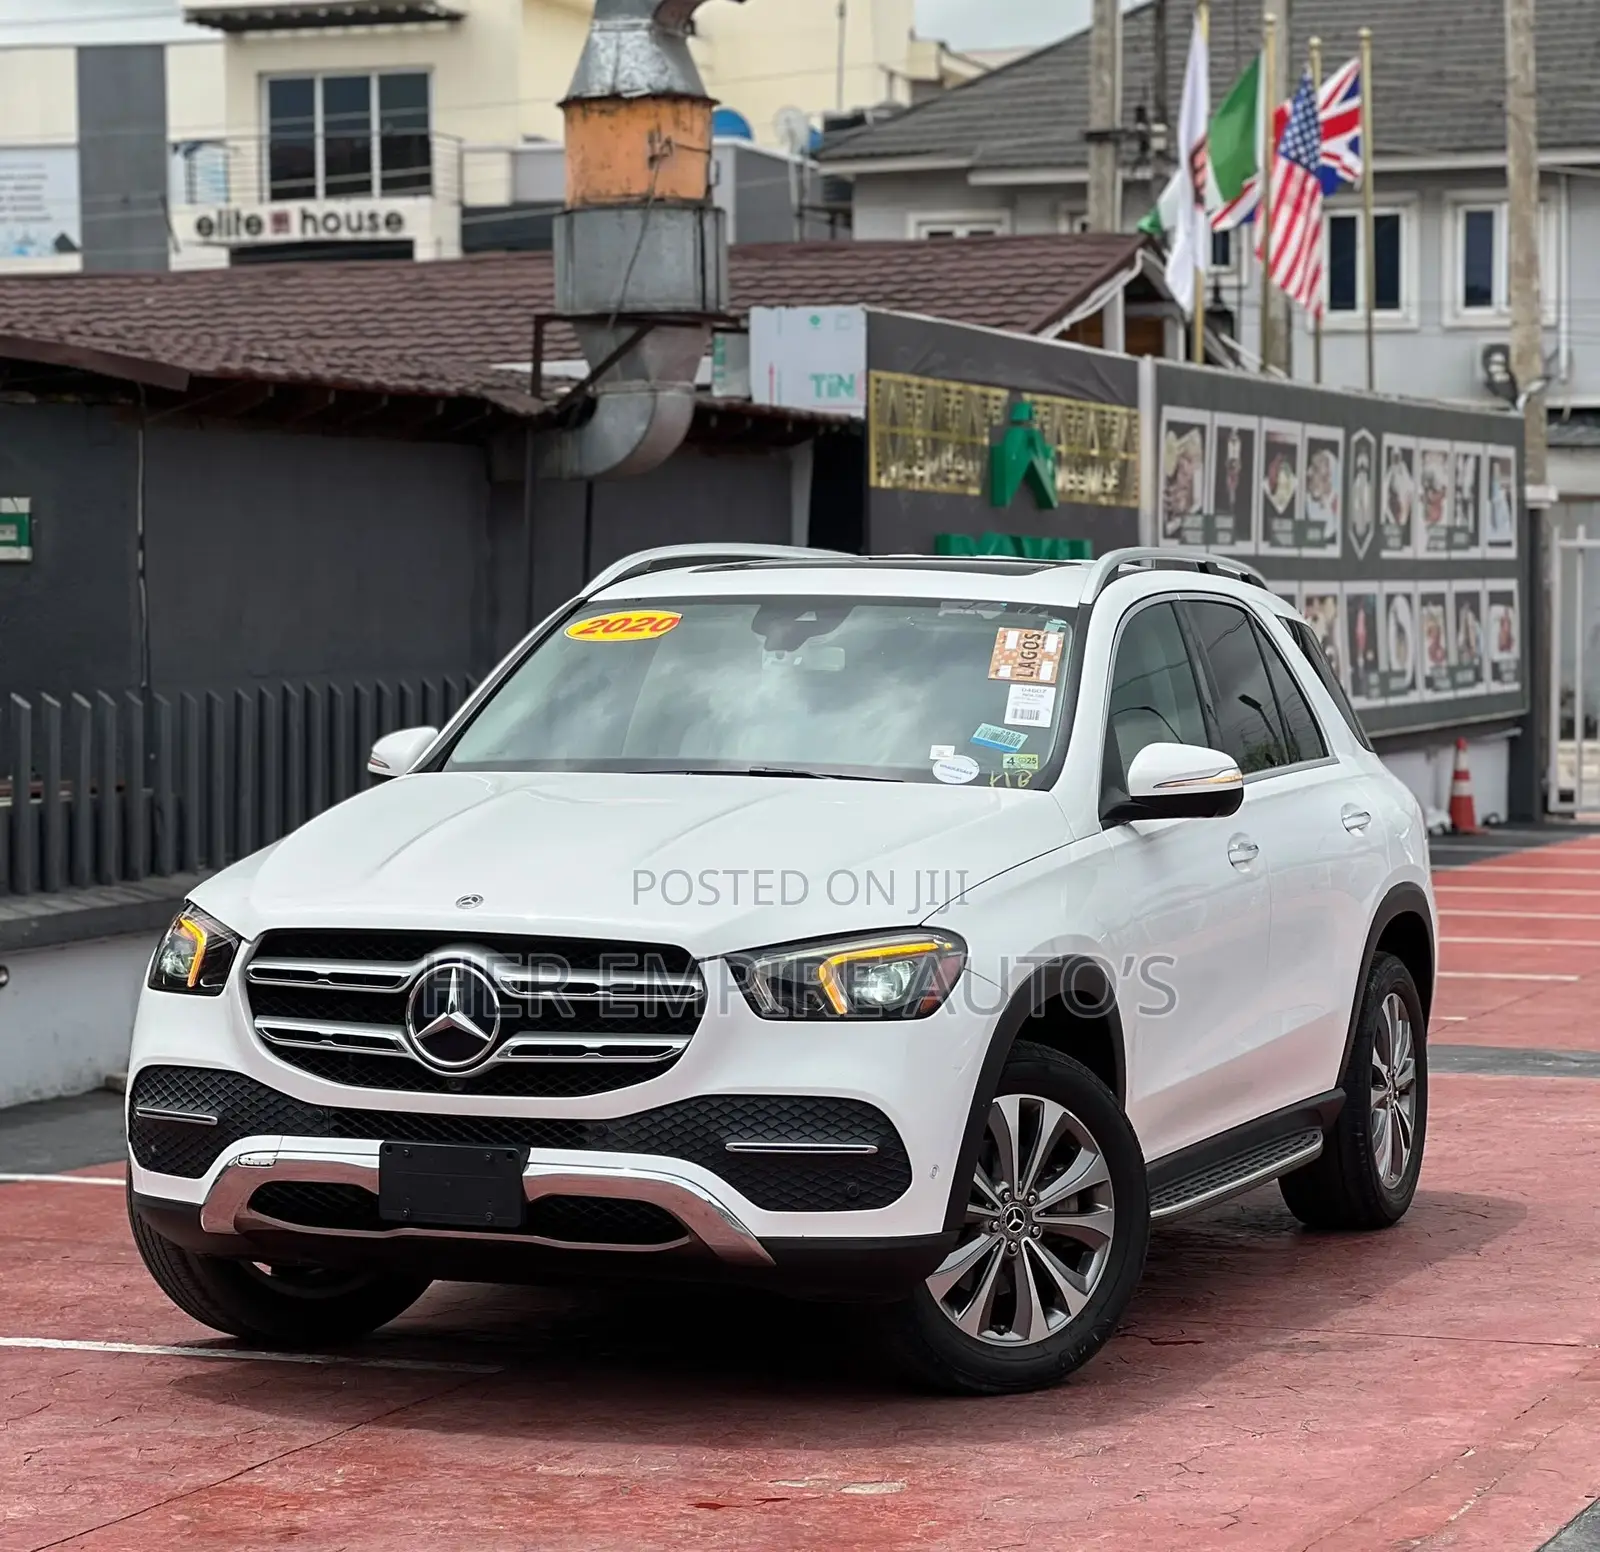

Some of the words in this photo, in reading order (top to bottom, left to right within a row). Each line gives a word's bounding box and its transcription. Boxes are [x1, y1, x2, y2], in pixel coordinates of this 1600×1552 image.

[195, 208, 263, 238] elite
[301, 207, 403, 234] house
[575, 617, 681, 634] 2020
[1016, 633, 1042, 678] LAGOS
[1006, 756, 1015, 765] 4
[1026, 757, 1037, 765] 25
